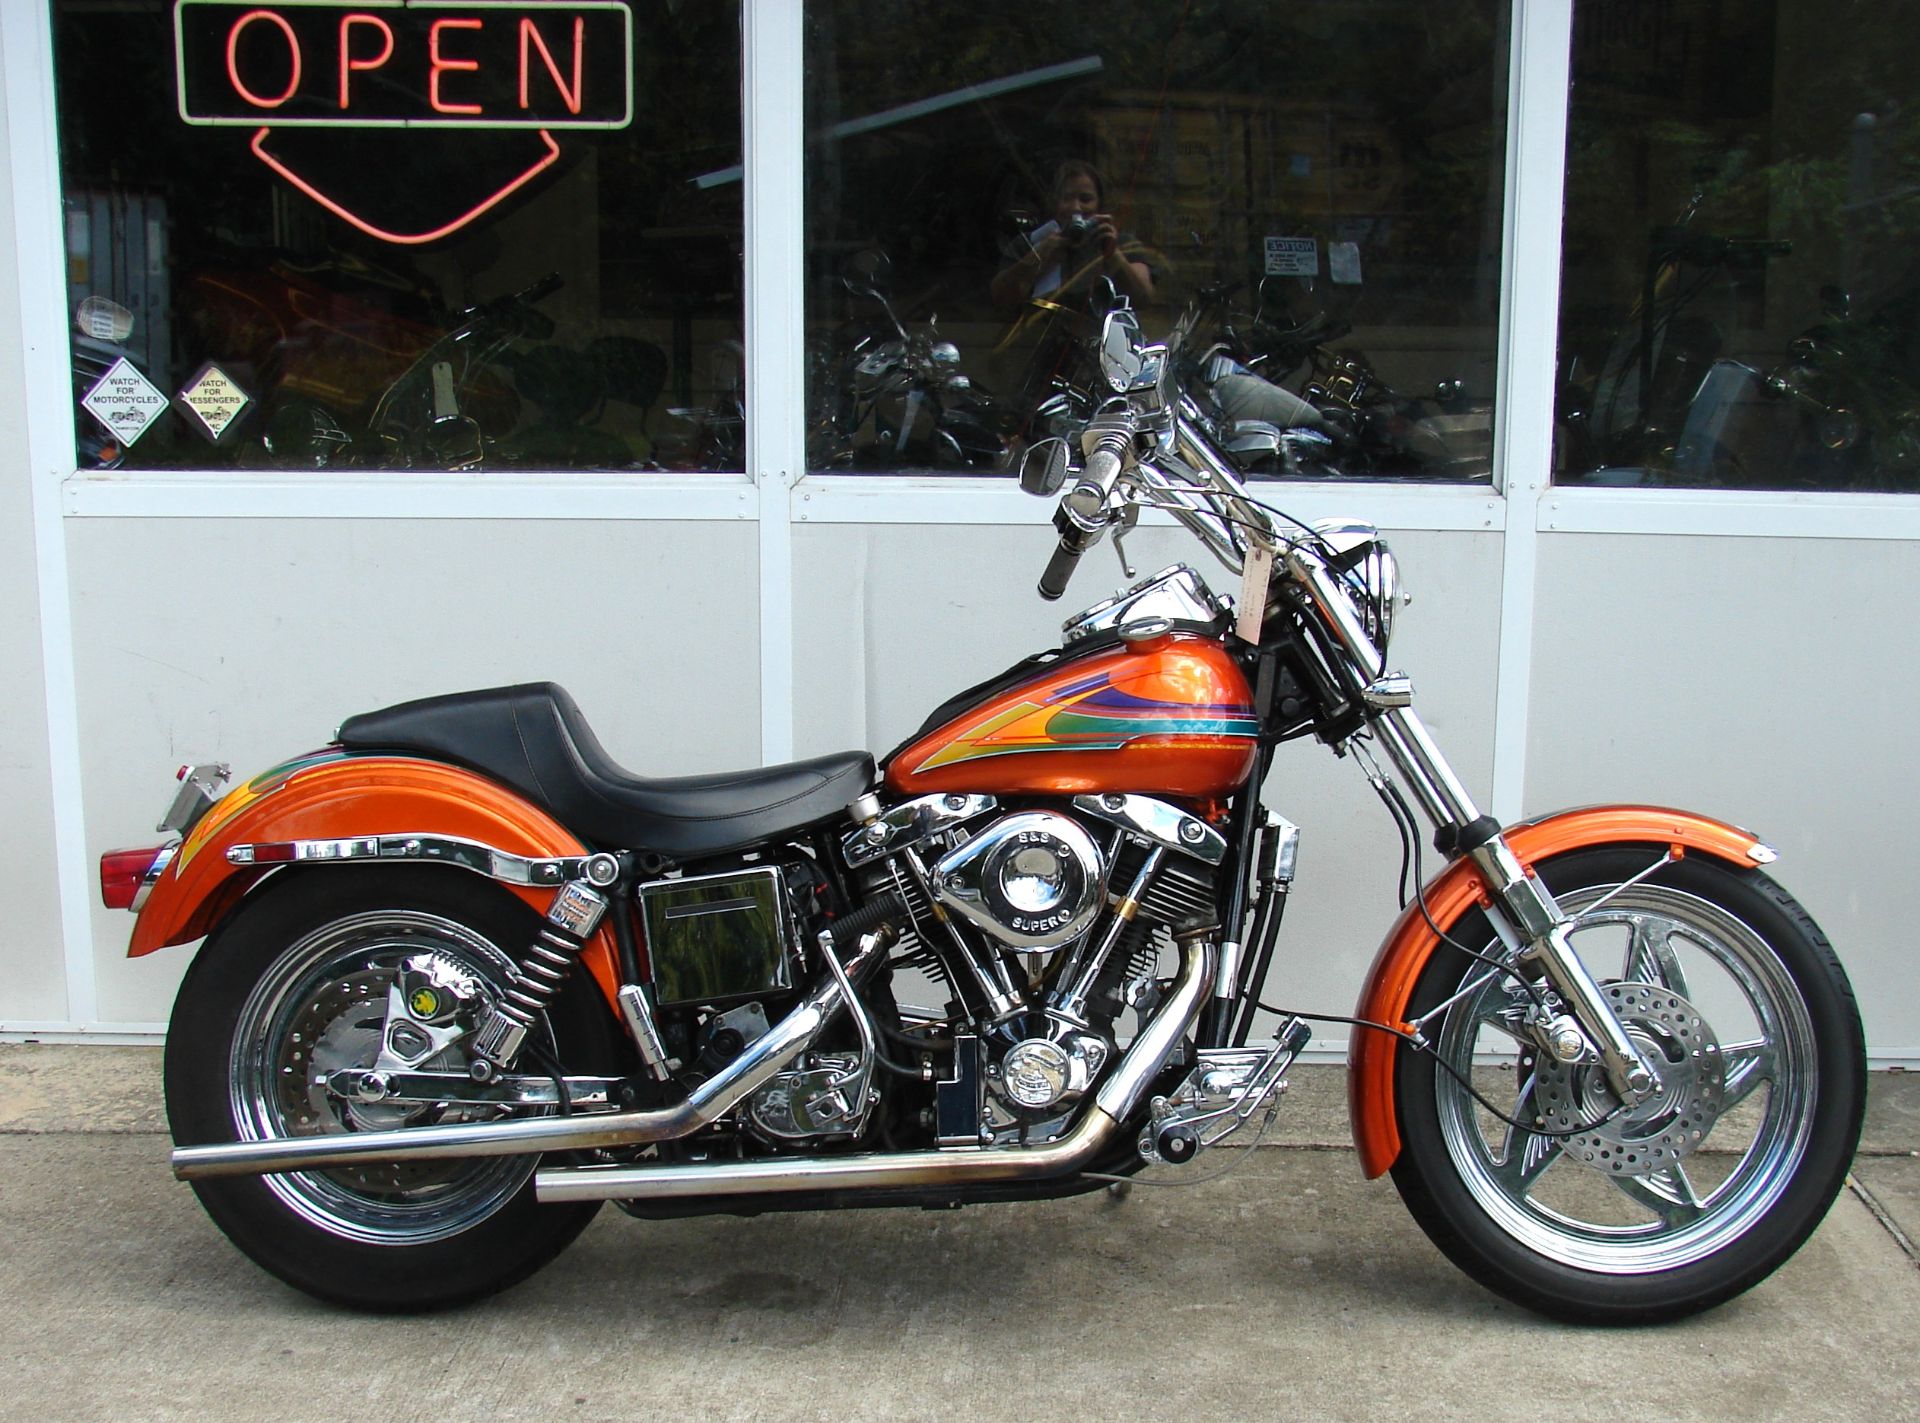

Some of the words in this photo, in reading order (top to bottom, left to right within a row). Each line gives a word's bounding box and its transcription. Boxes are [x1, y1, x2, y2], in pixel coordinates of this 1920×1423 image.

[225, 10, 584, 114] OPEN
[110, 378, 140, 386] WATCH
[93, 396, 159, 404] MOTORCYCLES
[1018, 831, 1050, 844] S&S
[1012, 917, 1060, 932] SUPER
